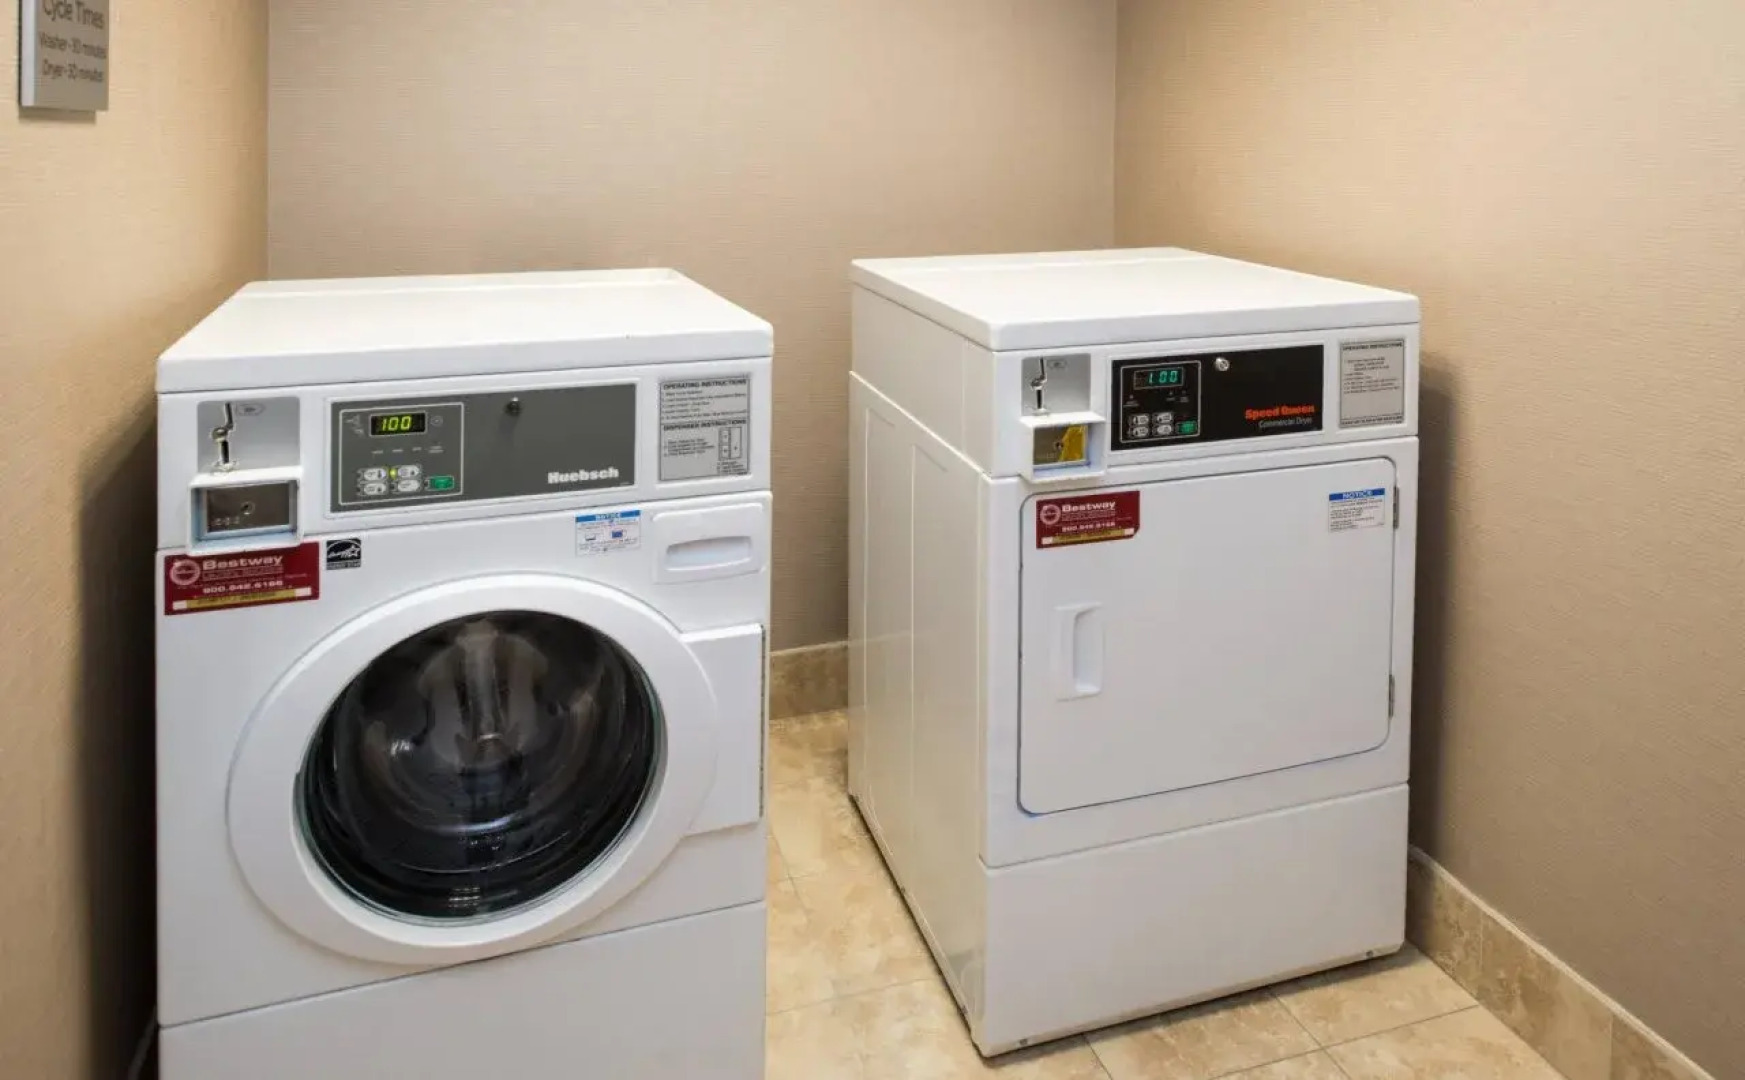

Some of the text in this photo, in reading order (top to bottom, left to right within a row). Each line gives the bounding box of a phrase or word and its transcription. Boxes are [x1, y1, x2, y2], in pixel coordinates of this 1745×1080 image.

[75, 0, 105, 30] Times
[1245, 404, 1315, 420] Speed Queen
[547, 465, 619, 484] Huebsch
[1062, 501, 1116, 513] Bestway
[202, 555, 284, 571] Bestway
